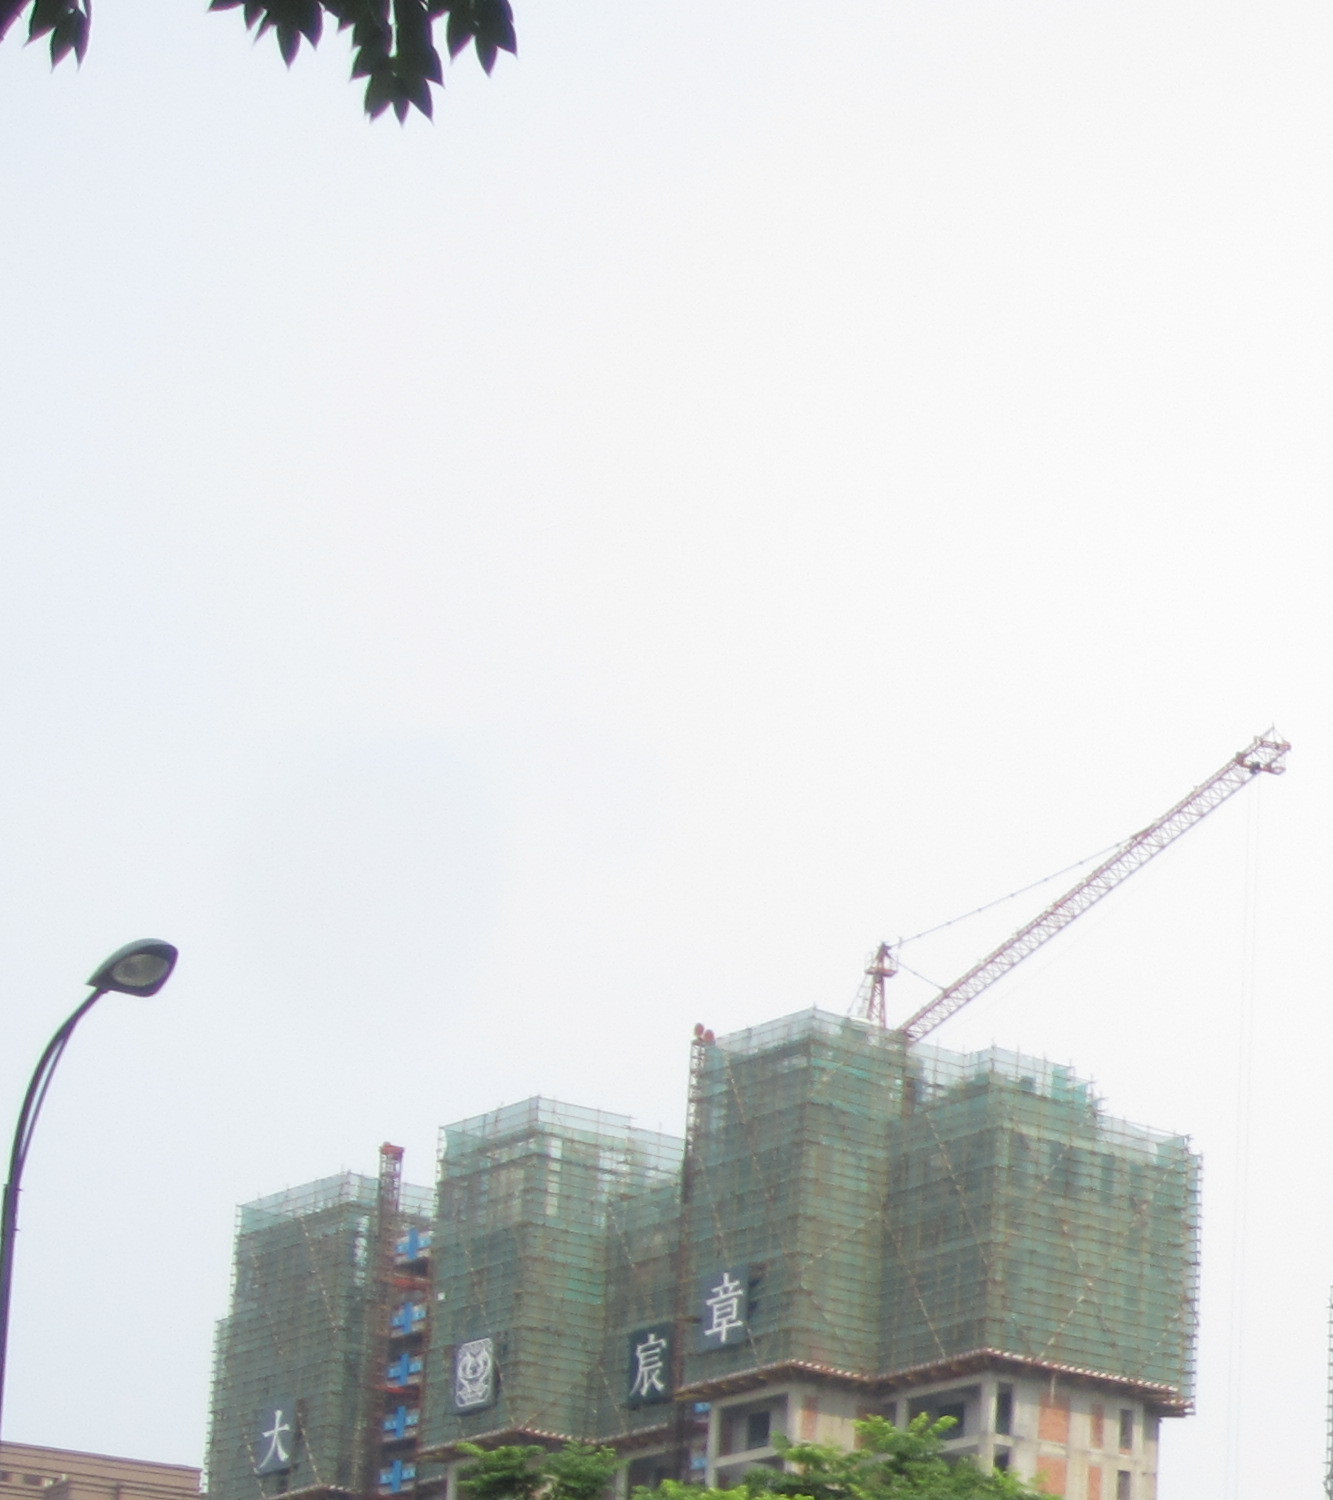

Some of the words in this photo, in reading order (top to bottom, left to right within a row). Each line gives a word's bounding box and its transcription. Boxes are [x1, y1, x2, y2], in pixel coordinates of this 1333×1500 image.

[260, 1409, 290, 1469] 大
[629, 1333, 665, 1397] 宸
[705, 1273, 744, 1343] 章
